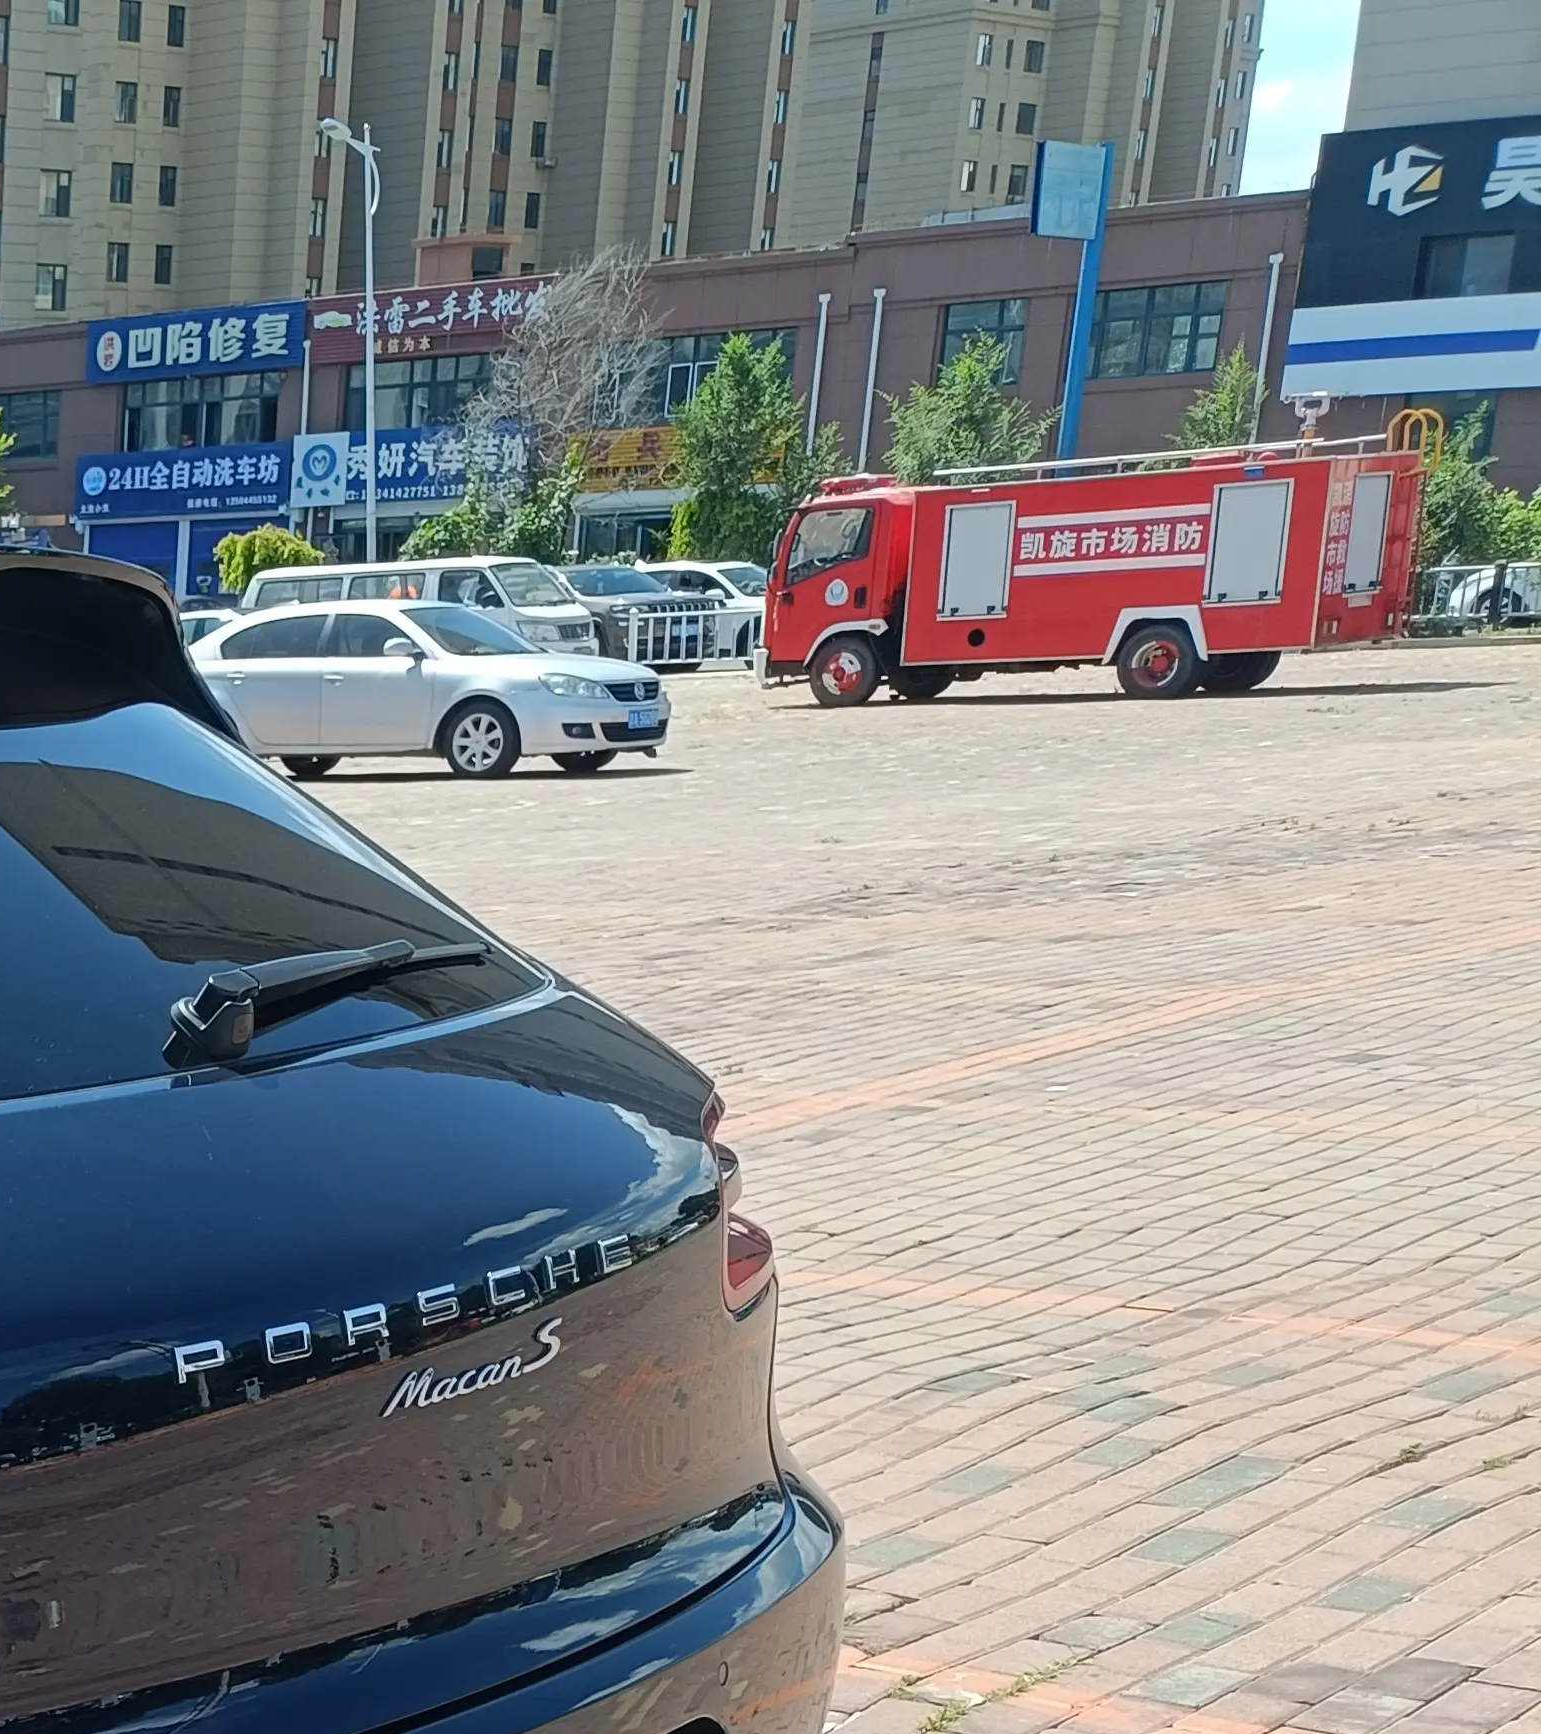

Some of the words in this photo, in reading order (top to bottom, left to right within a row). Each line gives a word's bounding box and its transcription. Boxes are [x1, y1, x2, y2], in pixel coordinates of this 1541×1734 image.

[127, 313, 290, 369] 凹陷修复
[108, 453, 280, 491] 24H全自动洗车坊
[1019, 521, 1204, 560] 凯旋市场消防
[173, 1233, 633, 1384] PORSCHE
[379, 1357, 522, 1418] Macan
[521, 1317, 563, 1374] S
